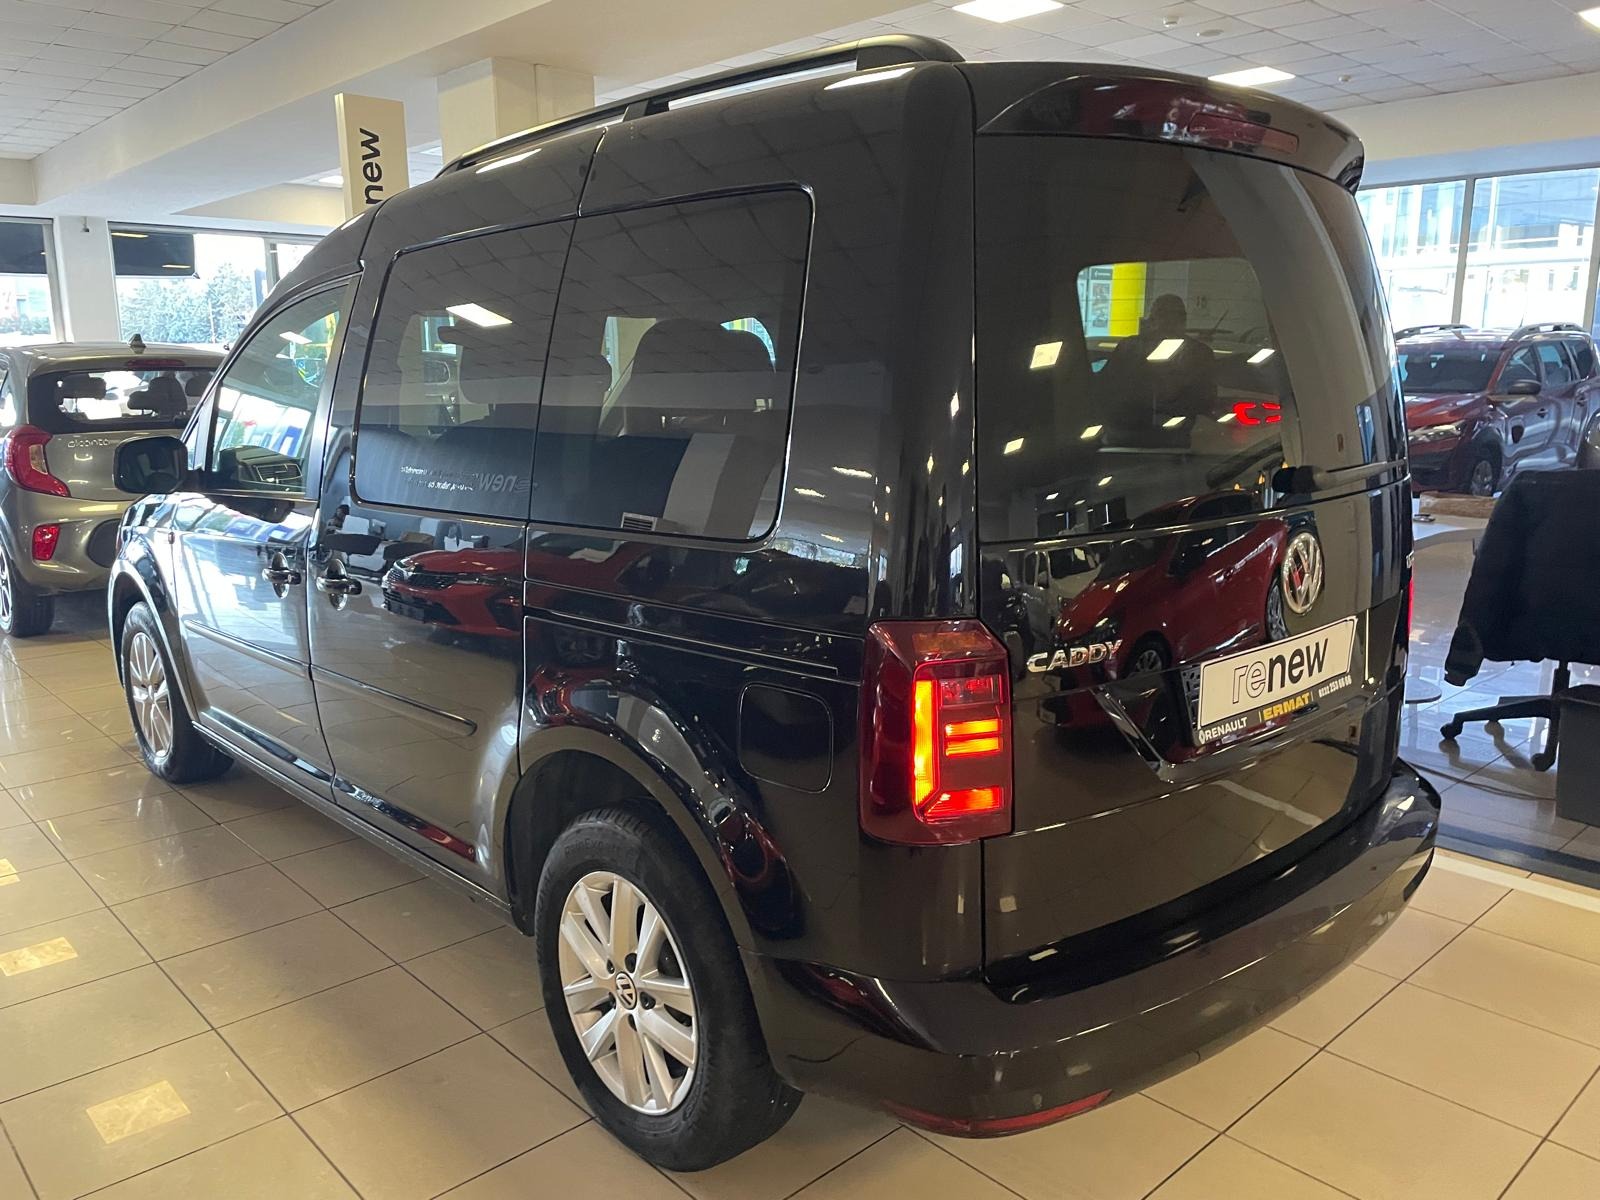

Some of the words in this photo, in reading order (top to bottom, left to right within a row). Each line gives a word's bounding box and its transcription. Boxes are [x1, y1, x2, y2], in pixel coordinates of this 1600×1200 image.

[1026, 639, 1123, 673] CADDY
[1232, 638, 1329, 704] renew
[1205, 716, 1248, 742] RENAULT
[1263, 692, 1310, 721] ERMAT
